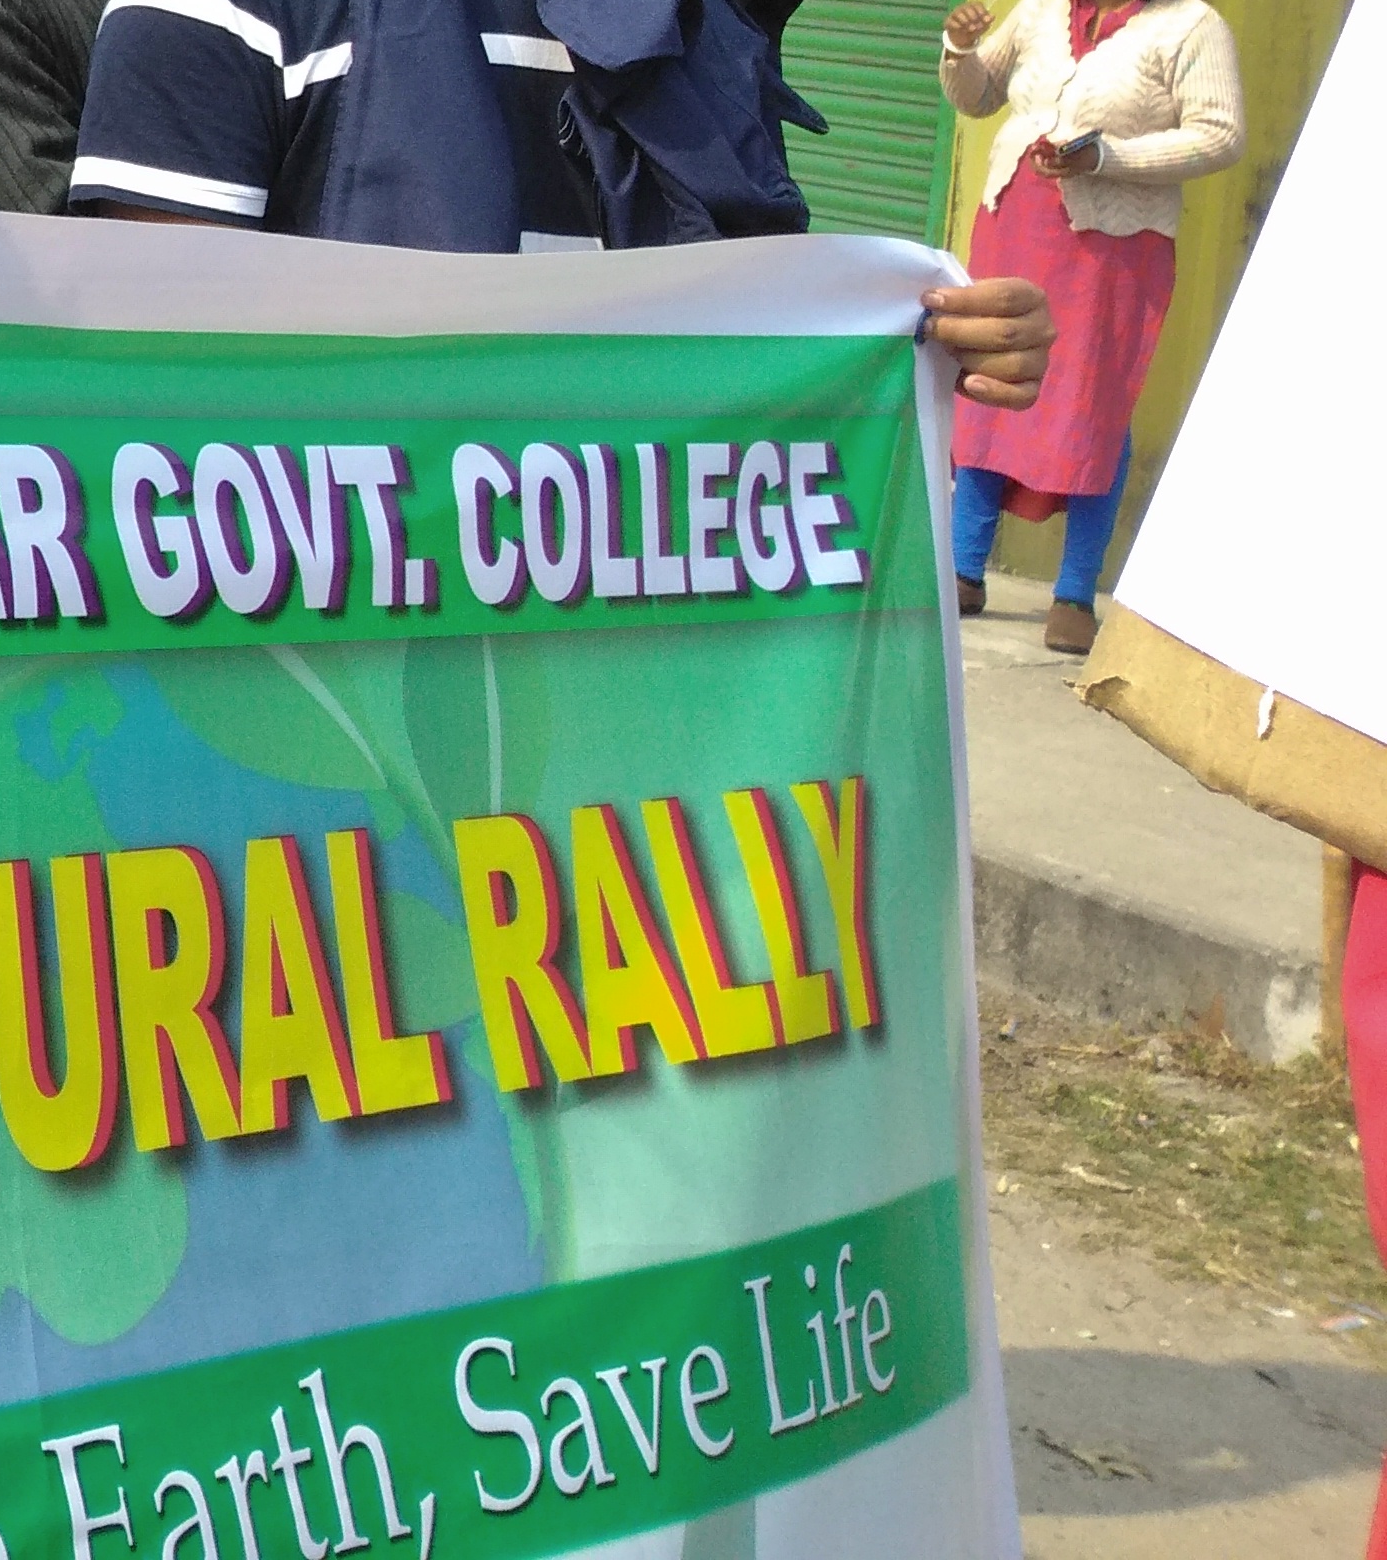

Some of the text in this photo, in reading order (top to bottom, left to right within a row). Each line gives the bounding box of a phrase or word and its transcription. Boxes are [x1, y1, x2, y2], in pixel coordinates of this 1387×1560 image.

[111, 440, 434, 620] GOVT.
[451, 440, 867, 607] COLLEGE
[453, 775, 882, 1094] RALLY
[453, 1336, 735, 1515] Save
[743, 1243, 897, 1437] Life
